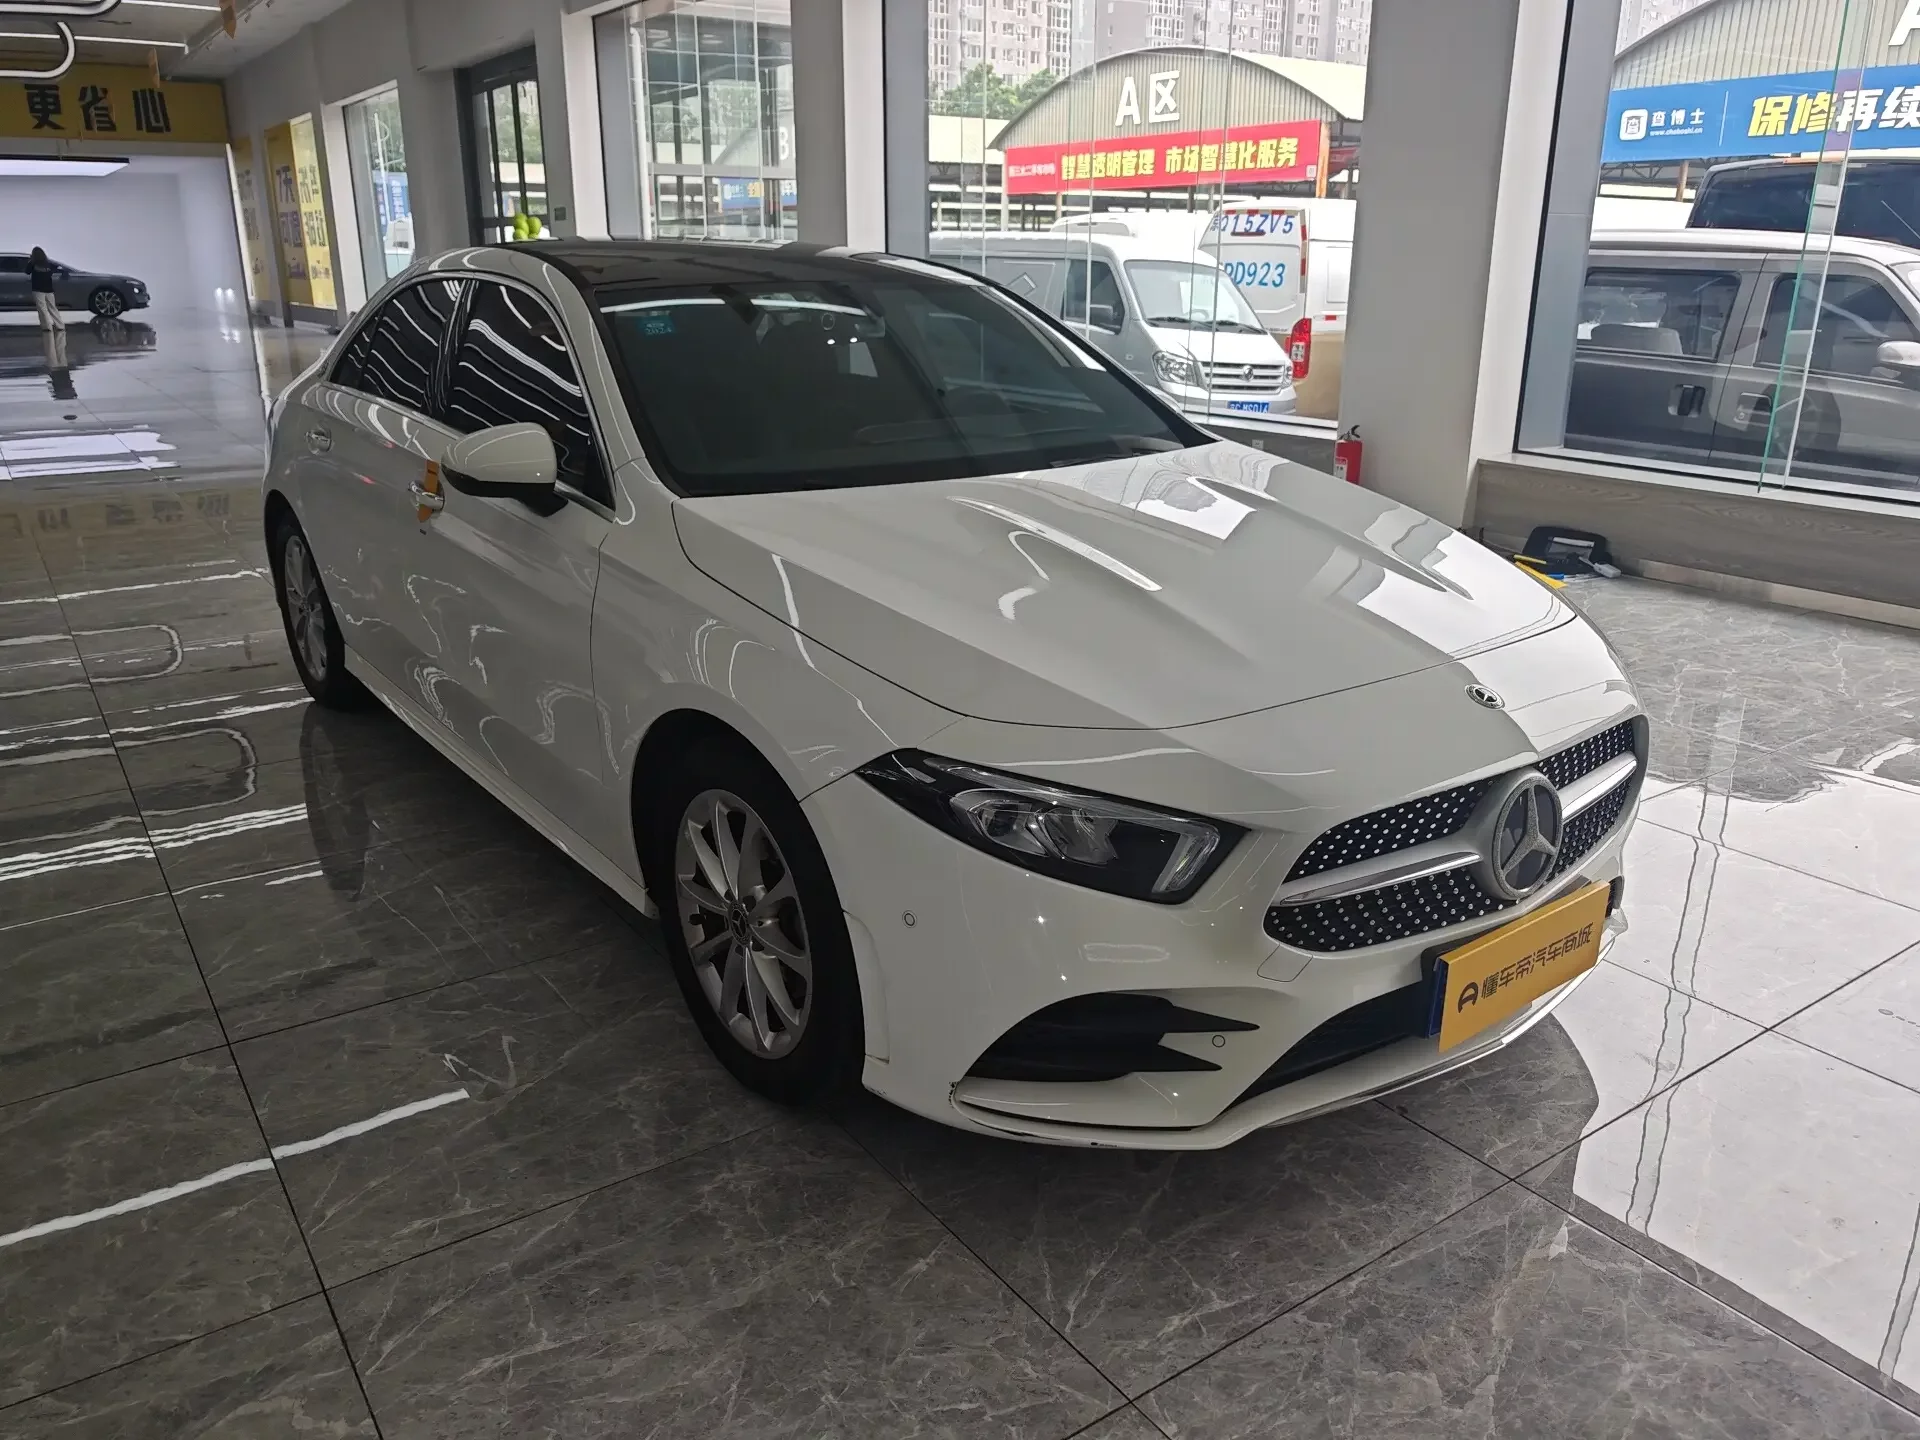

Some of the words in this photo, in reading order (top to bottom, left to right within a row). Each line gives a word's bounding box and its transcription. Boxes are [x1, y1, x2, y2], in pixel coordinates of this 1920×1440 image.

[24, 83, 172, 133] 更省心
[1114, 70, 1180, 127] A区
[1650, 107, 1705, 127] 查博士
[1061, 149, 1156, 180] 智慧透明管理
[1165, 137, 1299, 174] 市场智慧化服务
[1481, 921, 1594, 999] 懂车帝汽车商城
